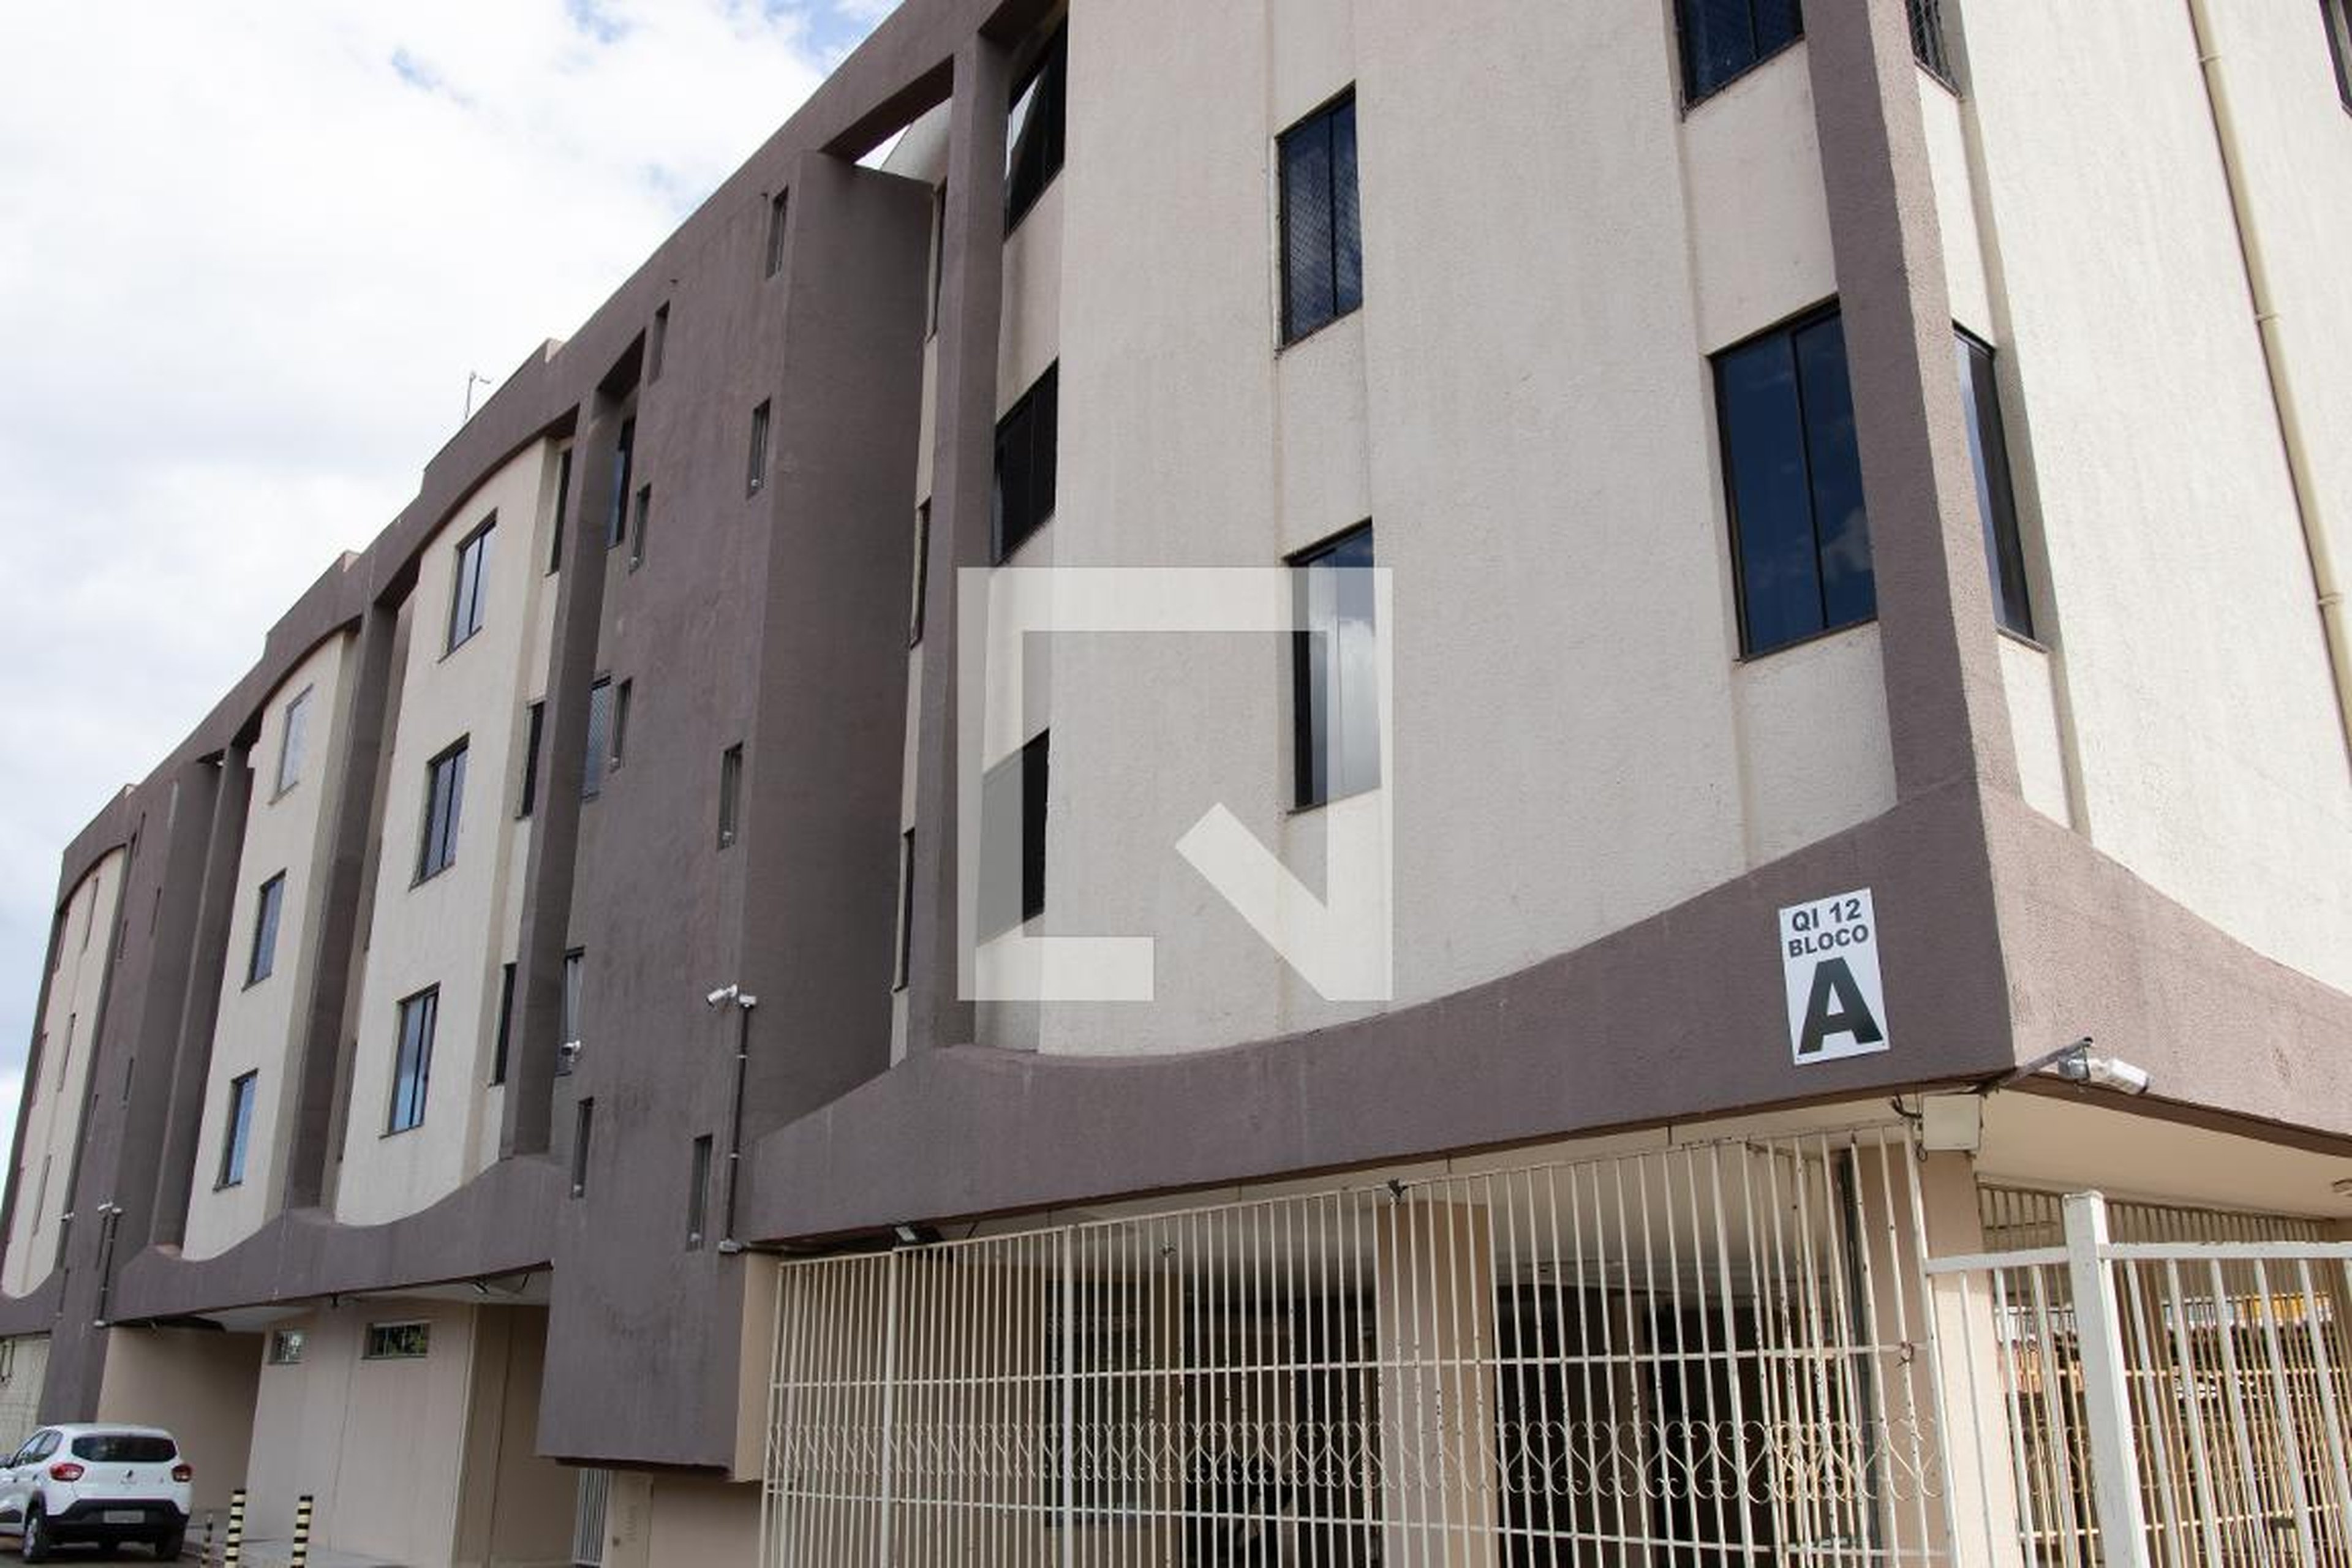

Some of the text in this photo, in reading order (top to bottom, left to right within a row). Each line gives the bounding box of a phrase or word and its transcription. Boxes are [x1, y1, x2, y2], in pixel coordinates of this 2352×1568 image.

[1792, 898, 1861, 932] QI 12
[1788, 924, 1869, 958] BLOCO
[1798, 957, 1883, 1055] A
